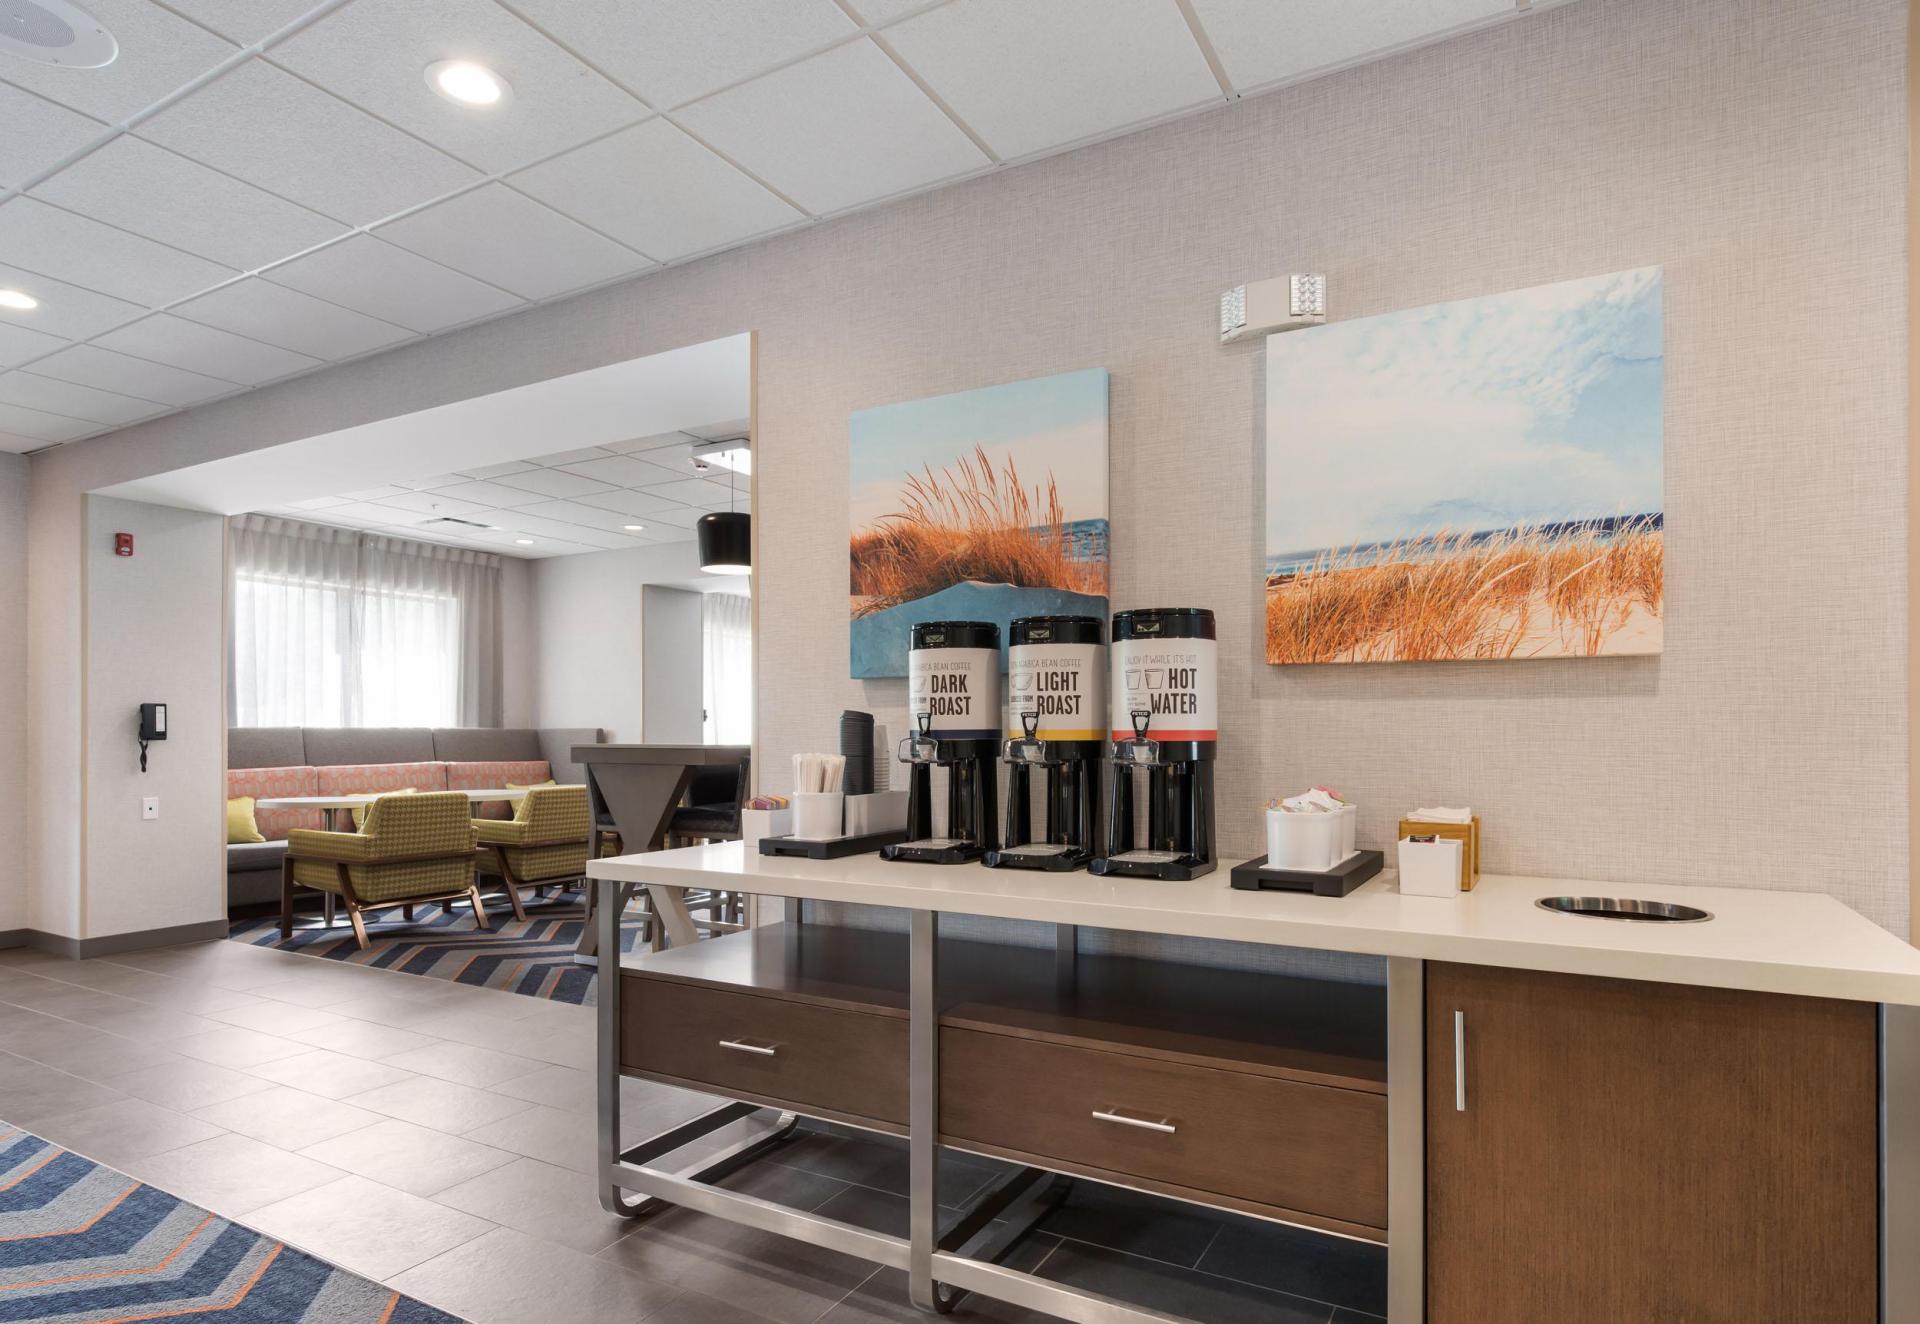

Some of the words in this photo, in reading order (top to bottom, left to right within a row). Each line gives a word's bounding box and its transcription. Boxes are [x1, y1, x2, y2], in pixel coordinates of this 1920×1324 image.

[933, 662, 949, 671] BEAN
[950, 662, 972, 671] COFFEE
[1041, 658, 1058, 667] BEAN
[1059, 658, 1081, 667] COFFEE
[1142, 654, 1148, 665] IT
[1149, 654, 1170, 665] WHILE
[1186, 654, 1197, 664] HOT
[931, 674, 968, 694] DARK
[1036, 671, 1079, 692] LIGHT
[1168, 667, 1197, 690] HOT
[929, 696, 972, 716] ROAST
[1036, 694, 1082, 715] ROAST
[1150, 692, 1197, 715] WATER
